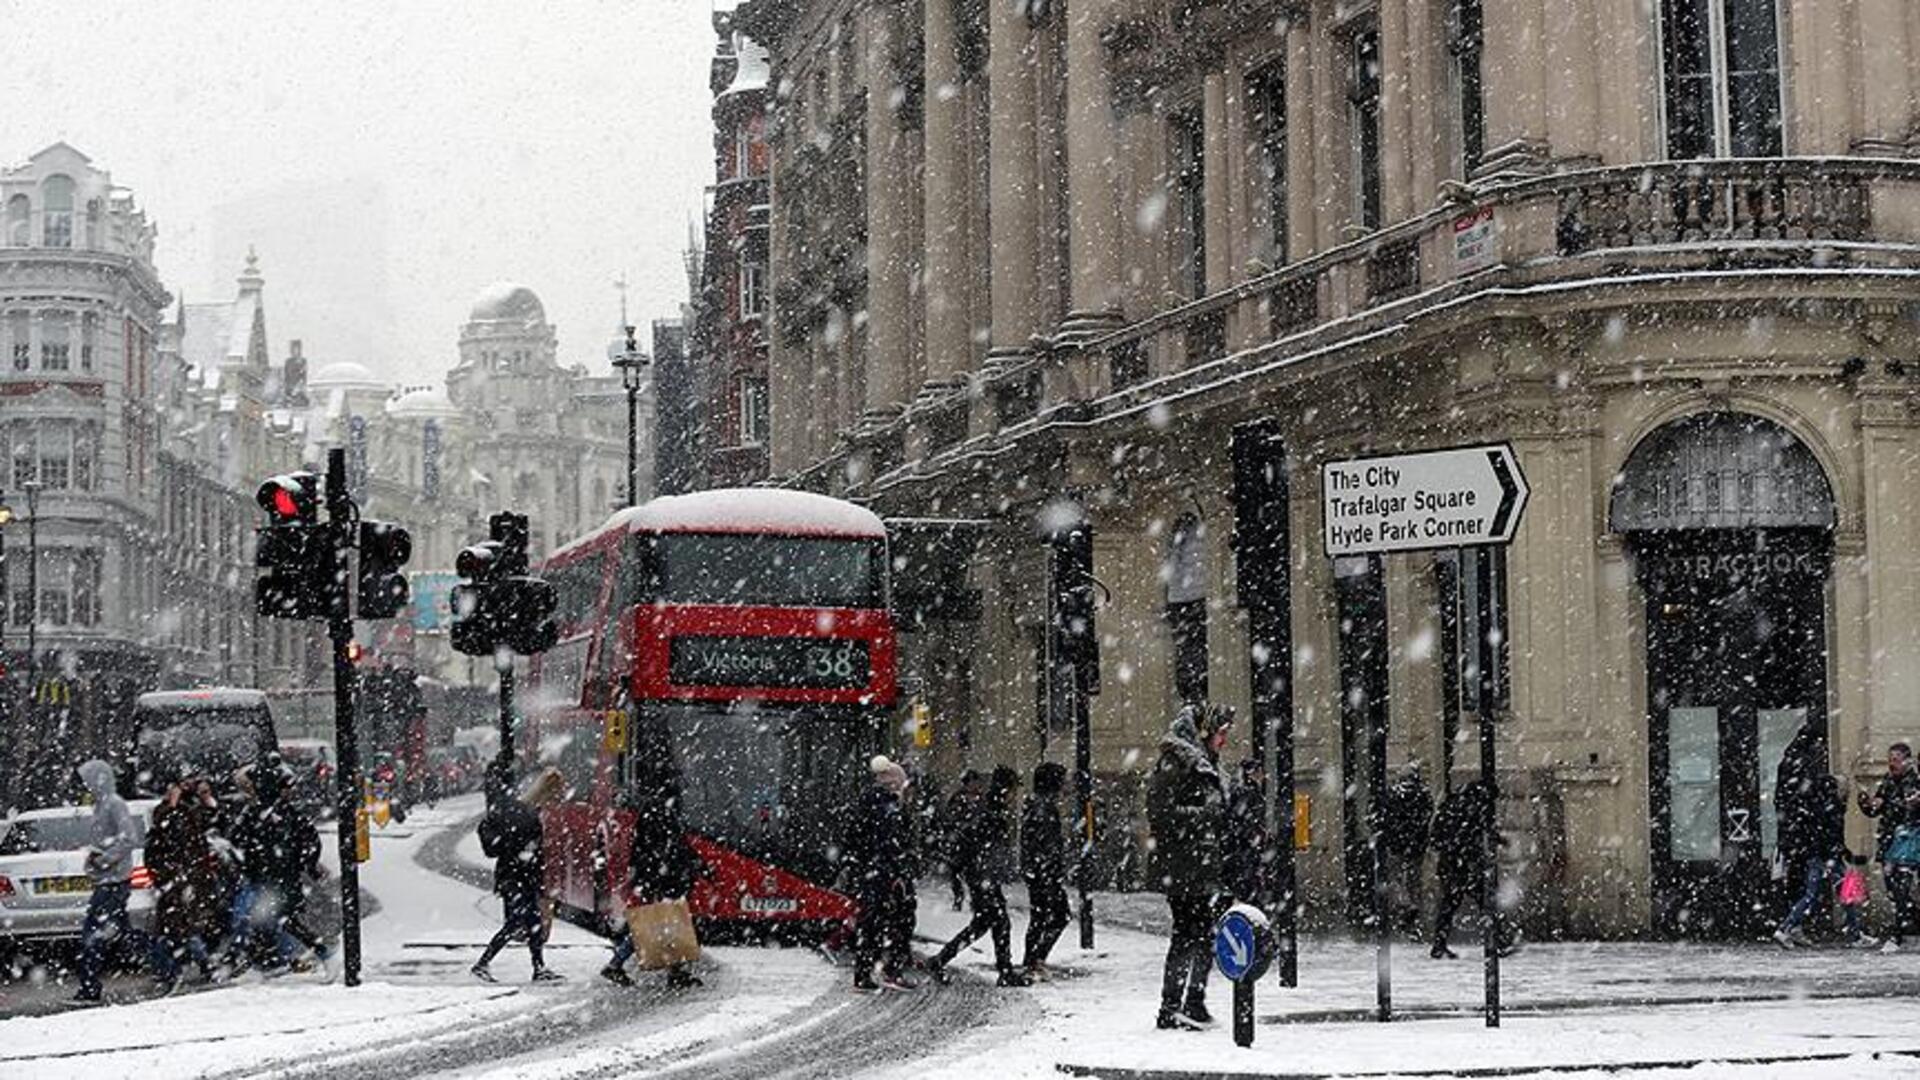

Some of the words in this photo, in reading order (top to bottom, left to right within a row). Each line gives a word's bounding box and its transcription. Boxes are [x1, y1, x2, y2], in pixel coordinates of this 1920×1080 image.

[1330, 471, 1360, 490] The
[1366, 466, 1401, 487] City
[1331, 495, 1407, 518] Trafalgar
[1414, 490, 1476, 513] Square
[1331, 524, 1374, 548] Hyde
[1380, 519, 1418, 541] Park
[1424, 517, 1484, 538] Corner
[702, 650, 775, 671] Victoria
[816, 649, 851, 676] 38
